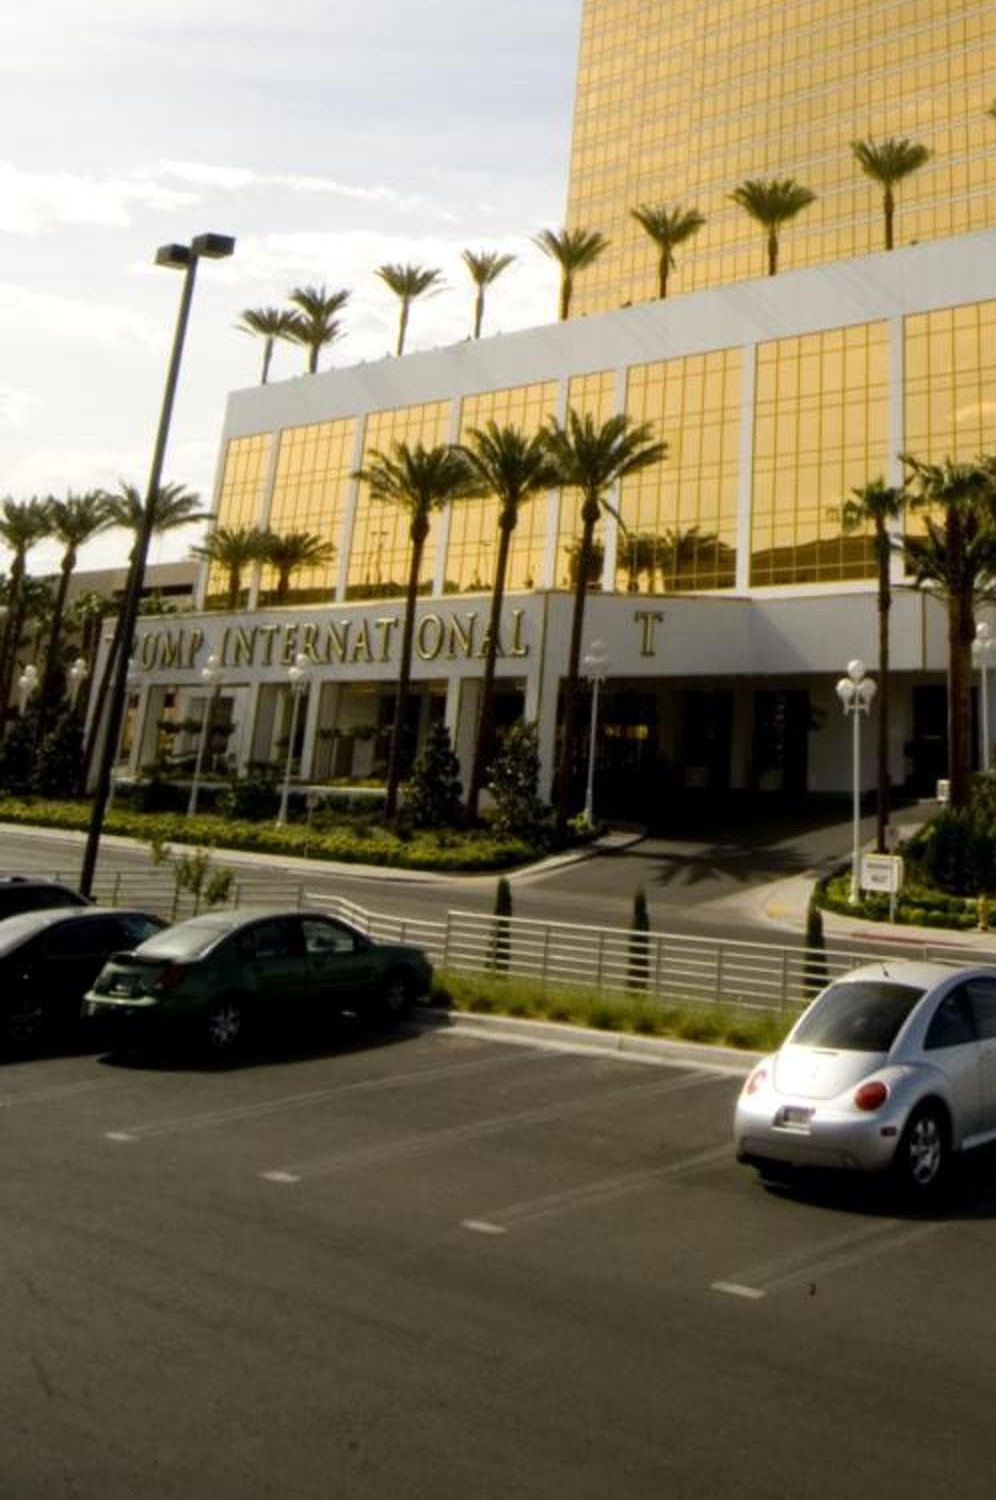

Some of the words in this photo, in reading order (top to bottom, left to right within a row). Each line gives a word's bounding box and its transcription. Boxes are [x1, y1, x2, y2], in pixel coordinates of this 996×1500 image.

[104, 628, 204, 672] UMP
[218, 608, 529, 668] INTERNATONAL
[634, 610, 663, 656] T
